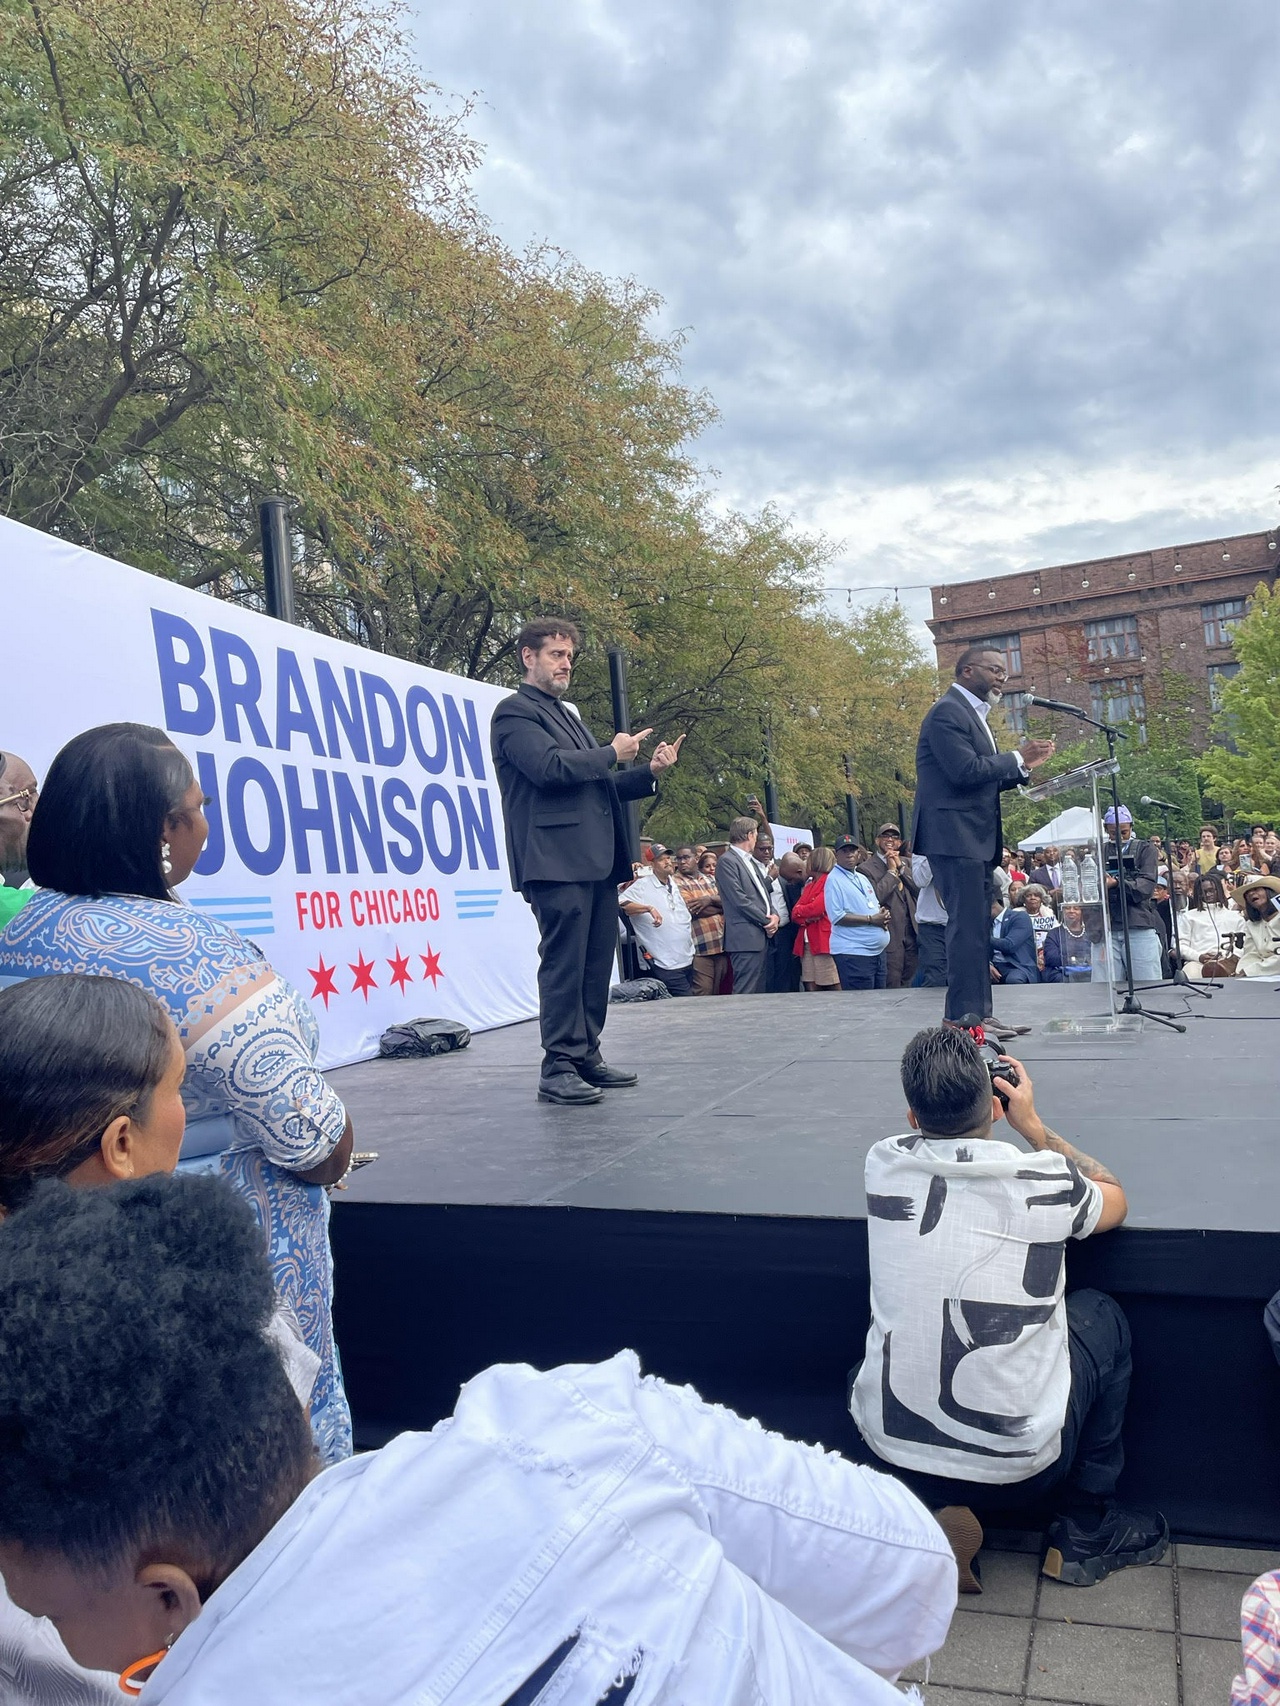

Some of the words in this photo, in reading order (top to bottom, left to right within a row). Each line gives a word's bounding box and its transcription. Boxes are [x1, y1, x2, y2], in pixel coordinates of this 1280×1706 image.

[150, 607, 486, 780] BRANDON
[192, 751, 500, 876] JOHNSON
[295, 891, 343, 931] FOR
[349, 888, 440, 927] CHICAGO
[1033, 915, 1055, 925] NDON
